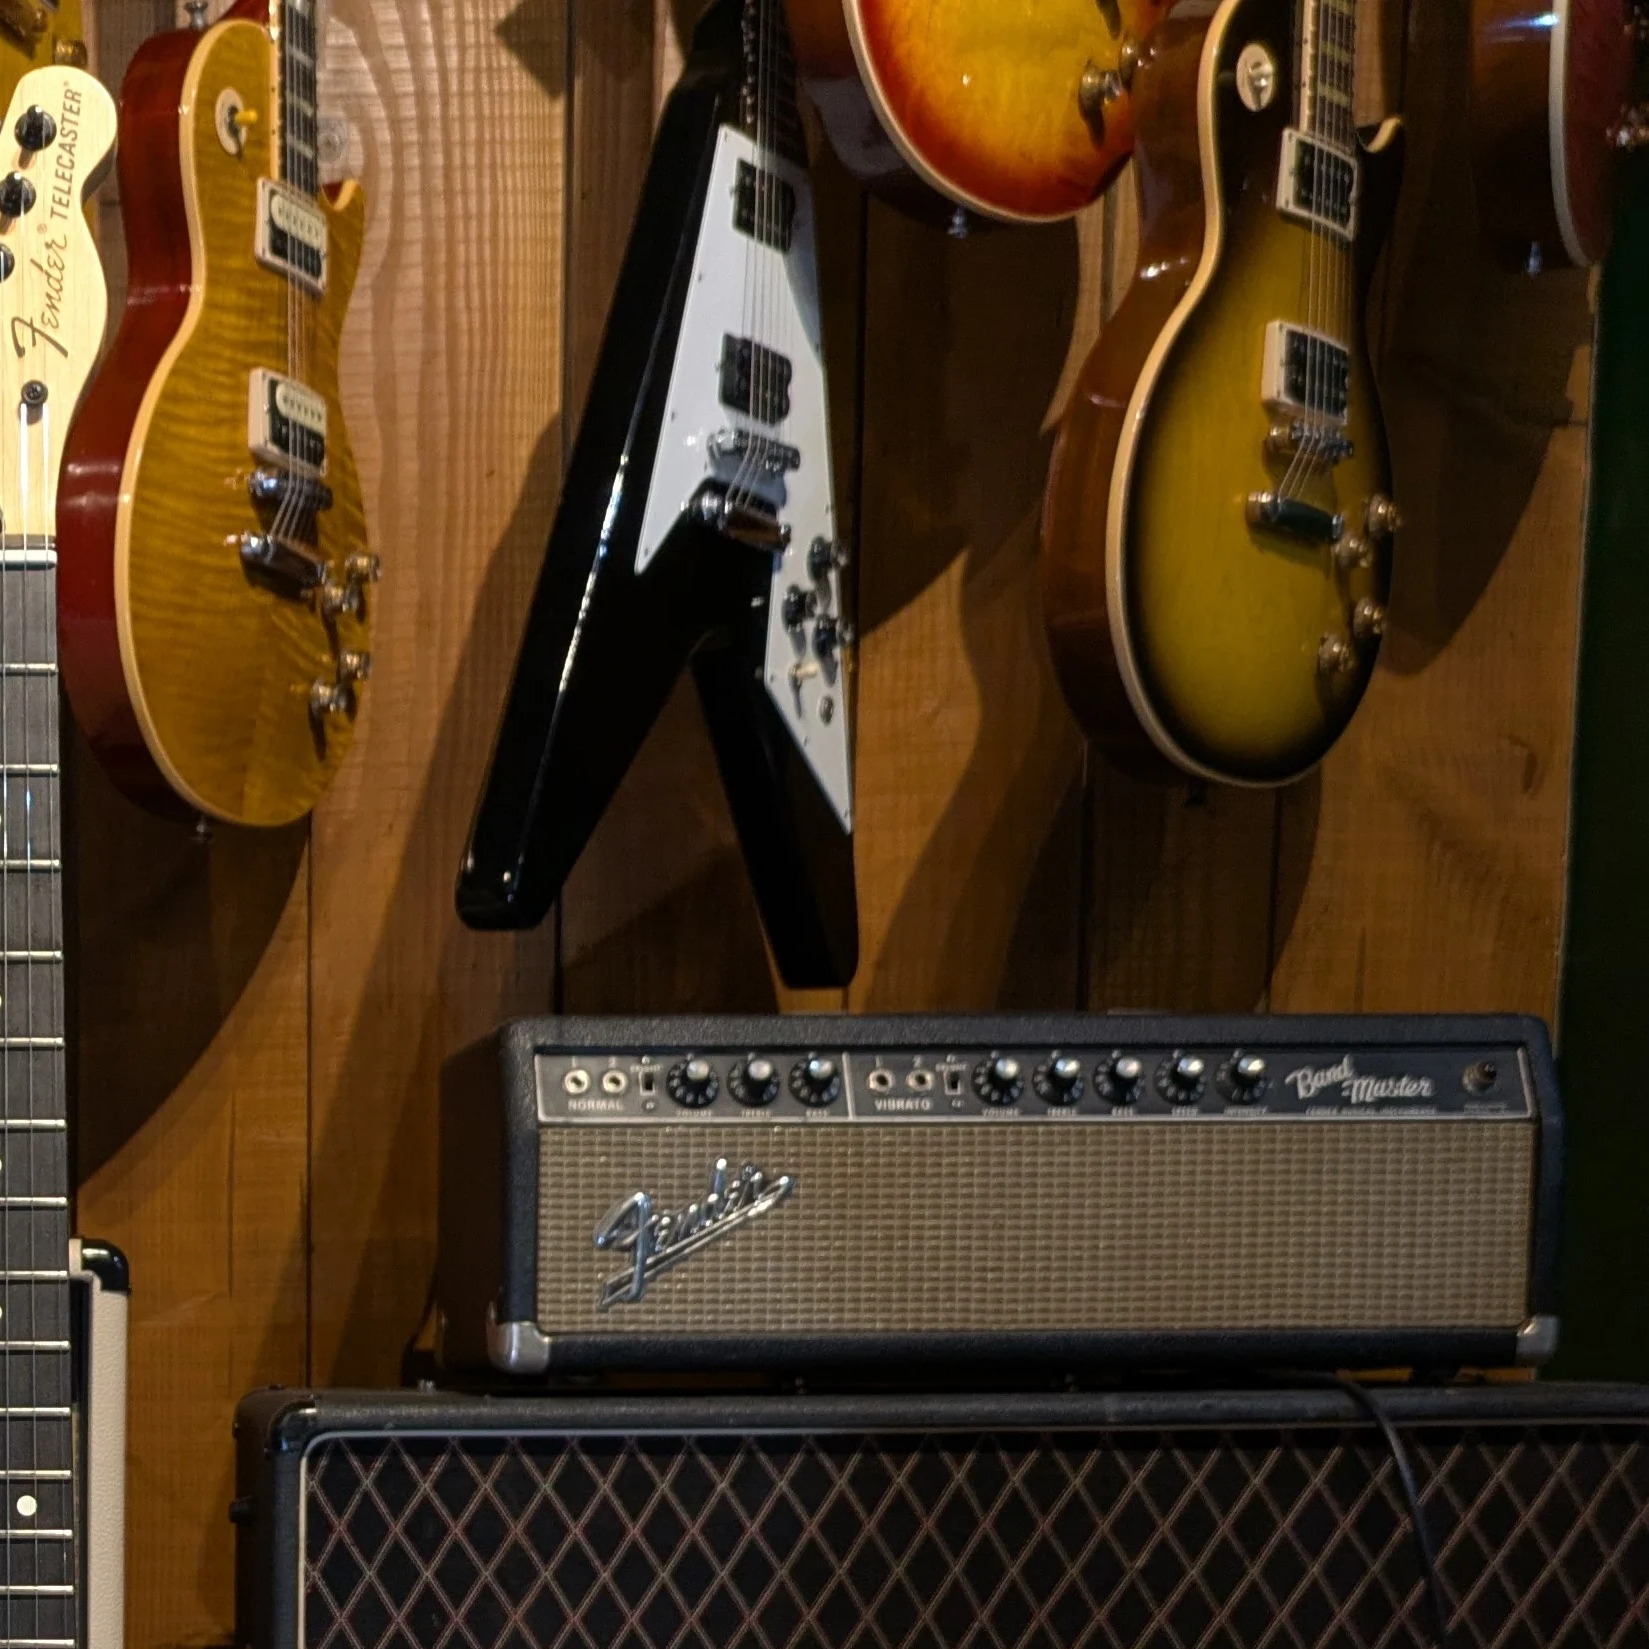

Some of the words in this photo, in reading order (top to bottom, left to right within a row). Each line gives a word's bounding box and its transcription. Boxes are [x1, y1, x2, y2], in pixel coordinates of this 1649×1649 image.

[50, 89, 83, 221] TELECASTER
[11, 233, 68, 358] Fender
[1284, 1054, 1354, 1099] Band
[1341, 1074, 1435, 1104] Master
[568, 1100, 625, 1111] NORMAL
[874, 1099, 932, 1111] VIBRATO
